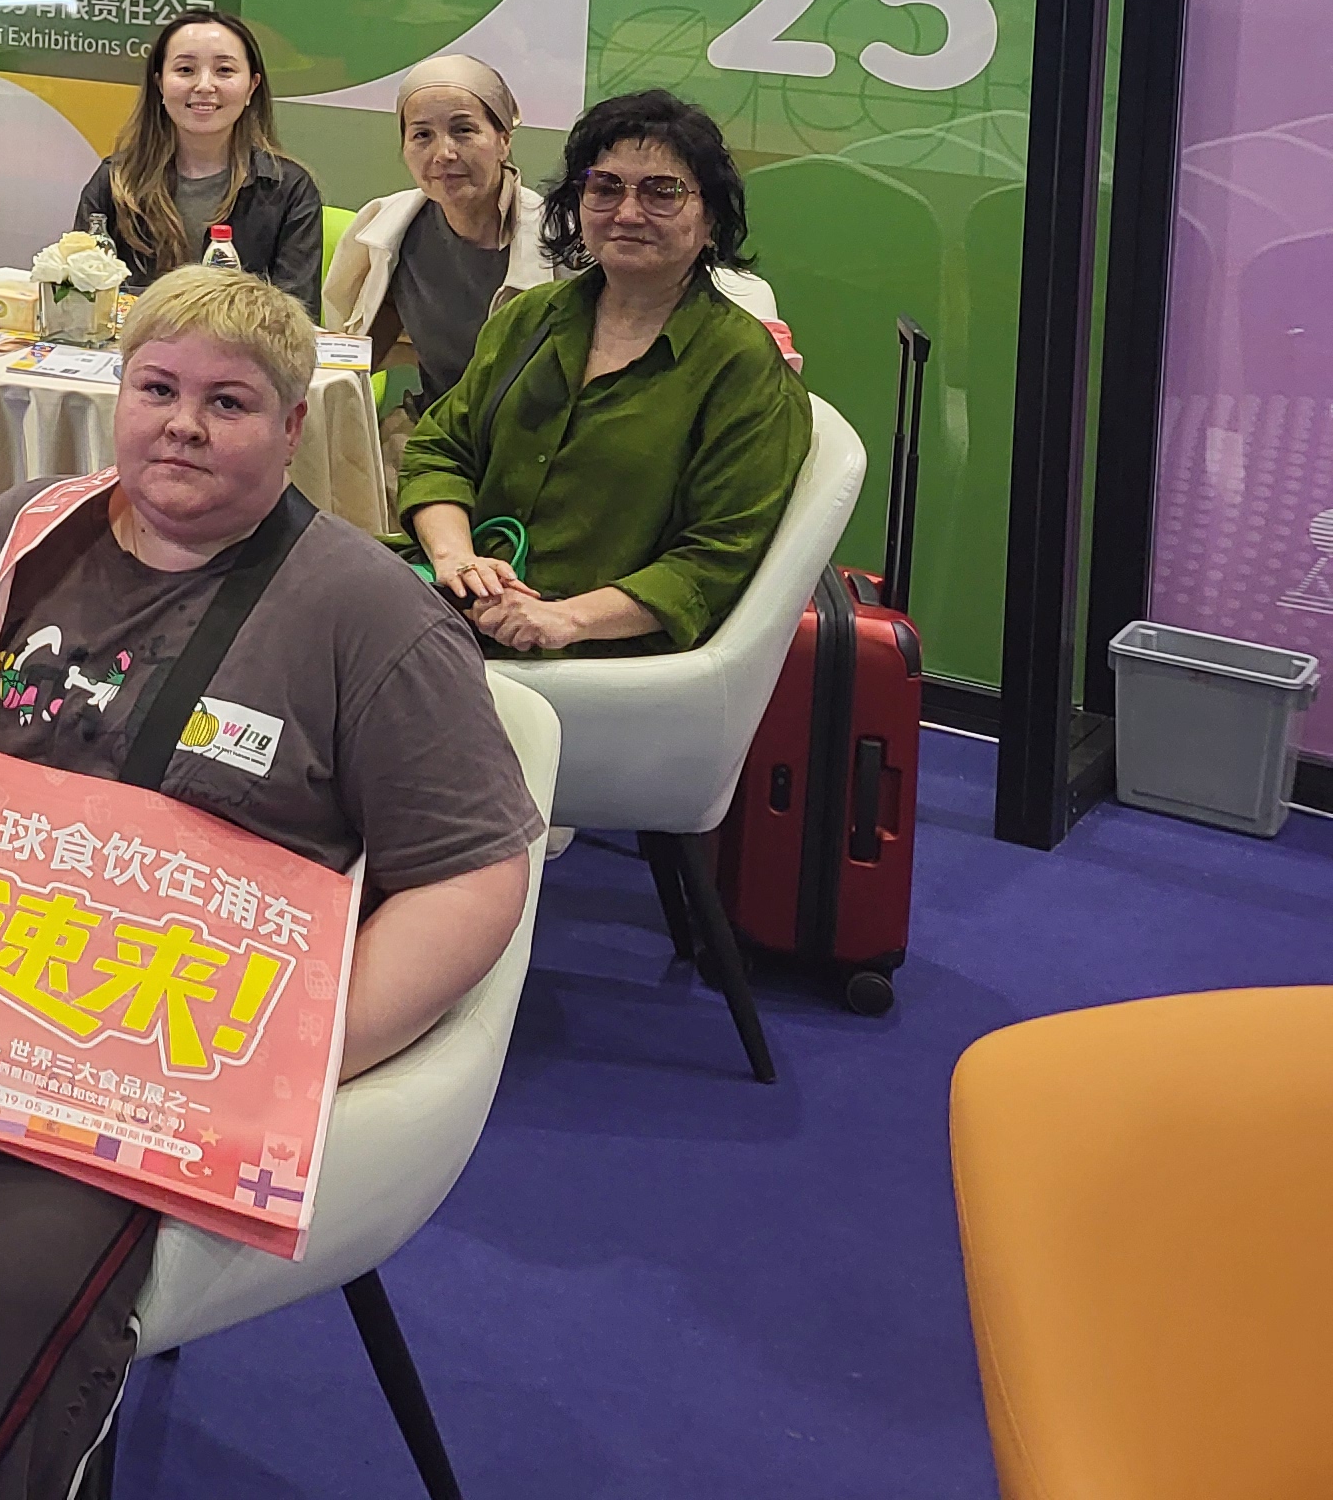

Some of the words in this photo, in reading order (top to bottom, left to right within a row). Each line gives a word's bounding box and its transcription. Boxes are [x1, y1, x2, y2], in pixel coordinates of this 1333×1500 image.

[8, 26, 121, 56] Exhibitions
[126, 38, 152, 58] Co
[10, 1037, 211, 1114] 世界三大食品展之一
